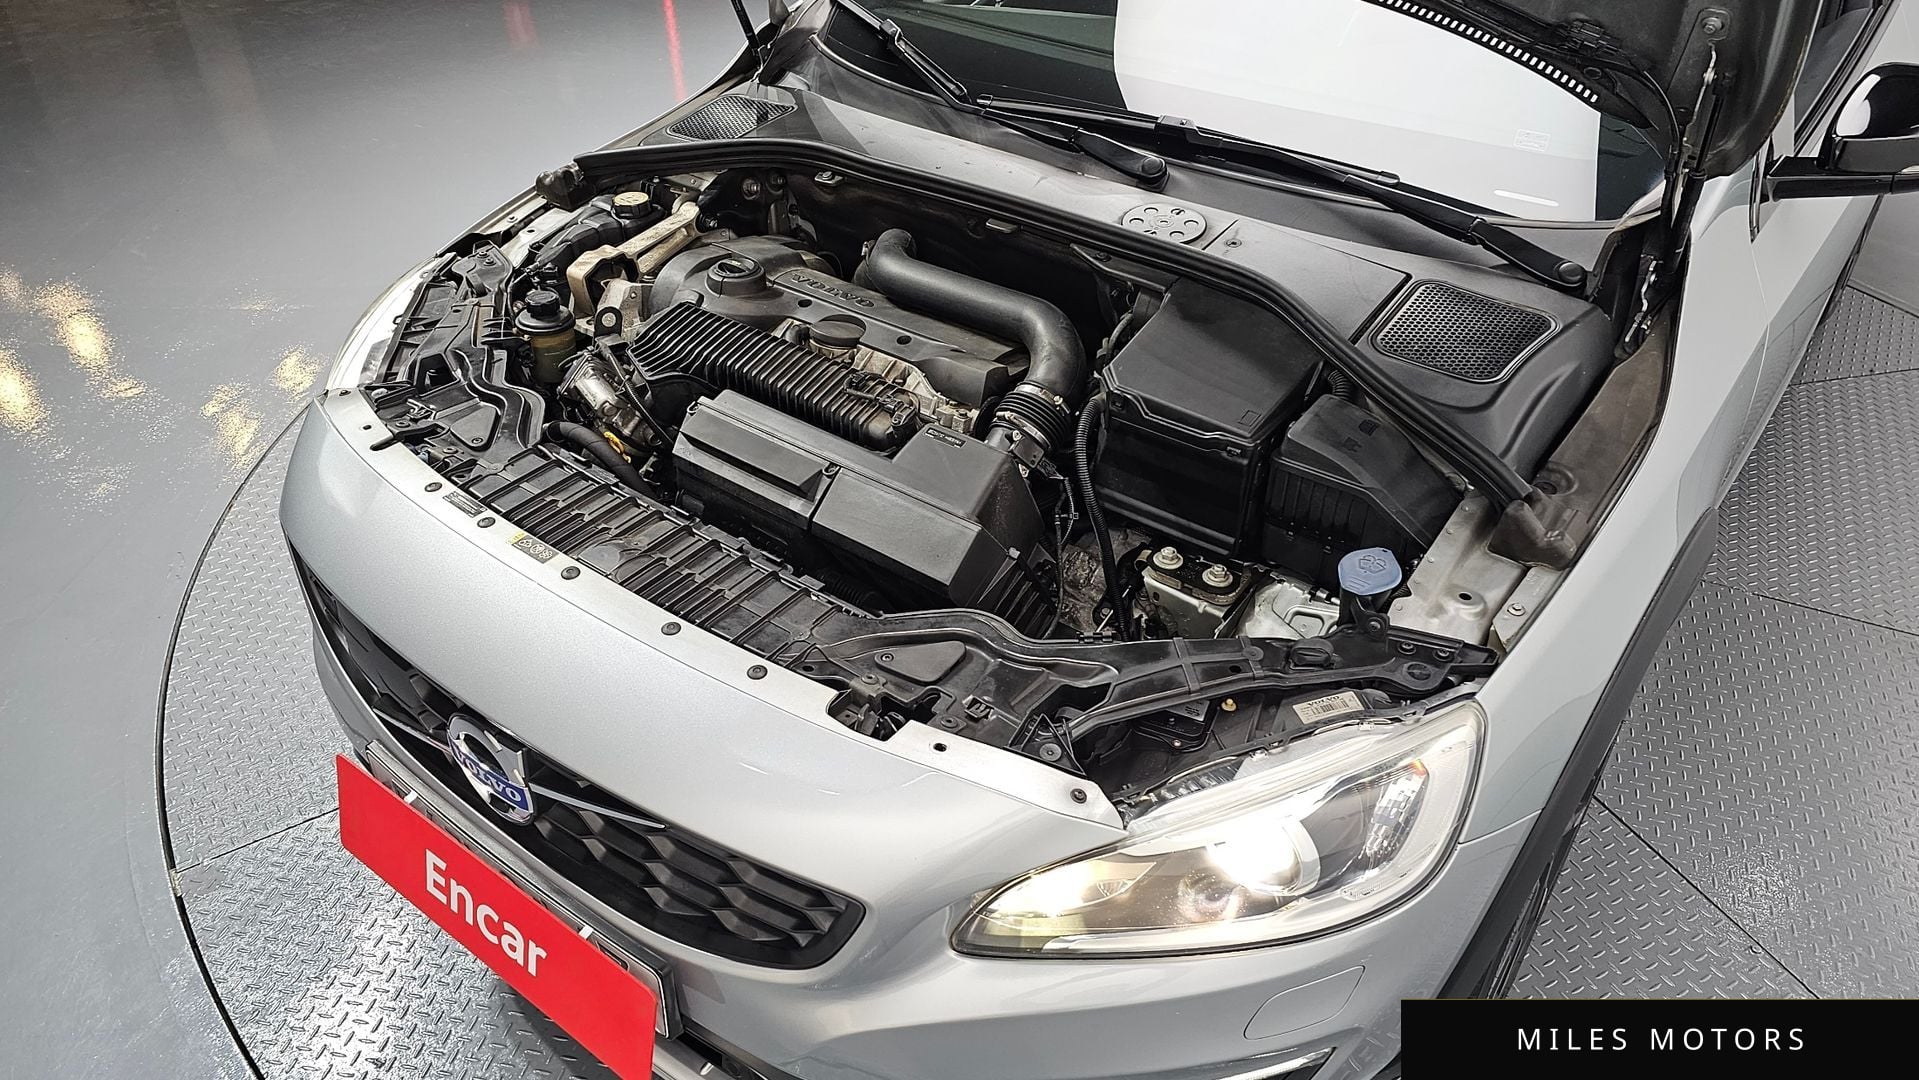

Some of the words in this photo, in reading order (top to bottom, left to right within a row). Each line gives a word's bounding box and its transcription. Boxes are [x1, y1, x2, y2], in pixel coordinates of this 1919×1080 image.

[791, 273, 875, 307] VOLVO
[1307, 695, 1340, 706] VOLVO
[451, 741, 522, 802] VOLVO
[425, 849, 547, 977] Encar
